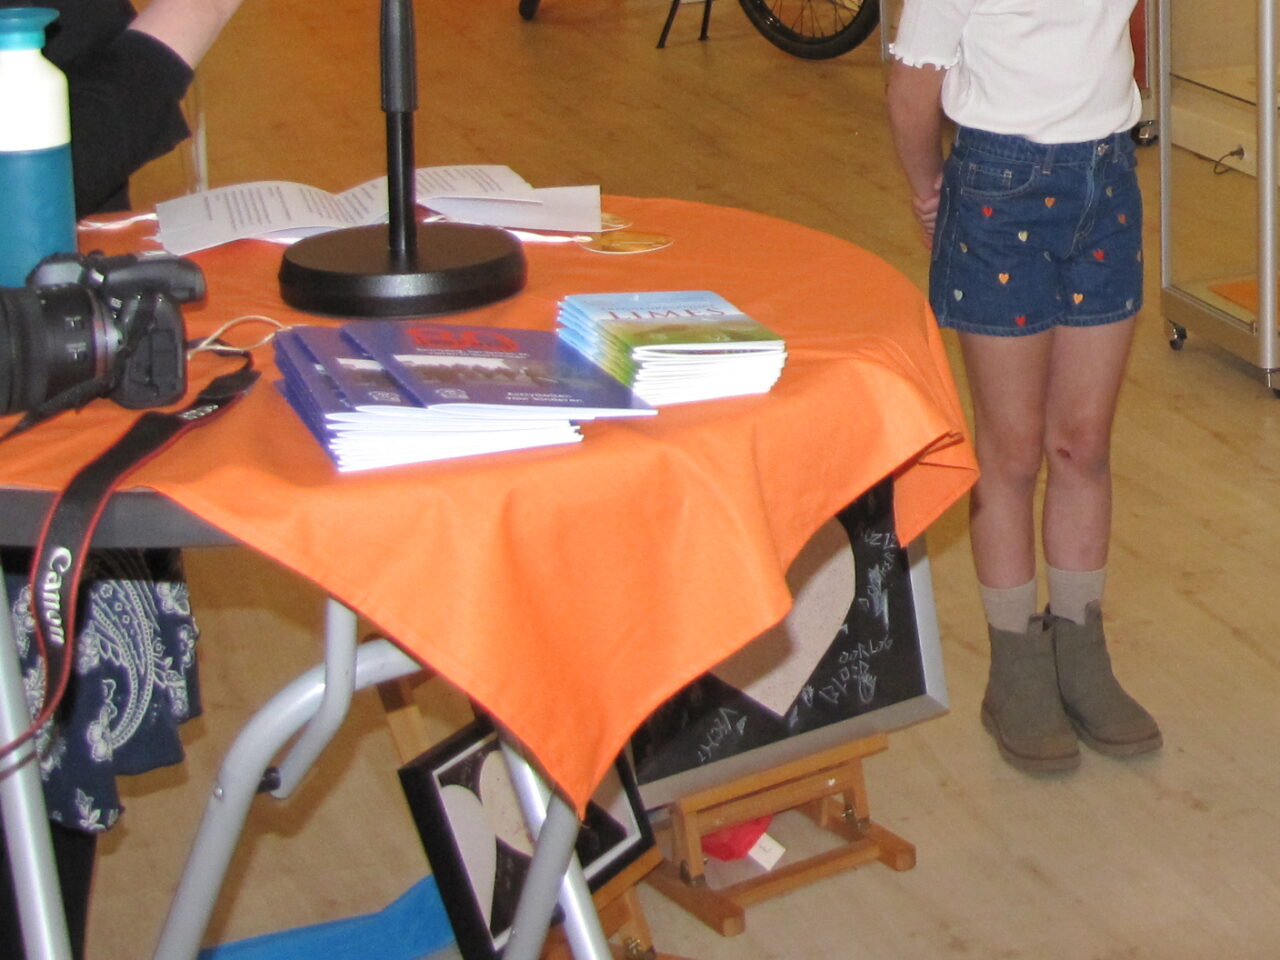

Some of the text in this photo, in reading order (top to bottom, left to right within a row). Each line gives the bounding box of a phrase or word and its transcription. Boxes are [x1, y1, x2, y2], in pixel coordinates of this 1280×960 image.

[608, 307, 725, 321] LIMES
[407, 326, 520, 352] 80
[40, 547, 73, 646] Canon
